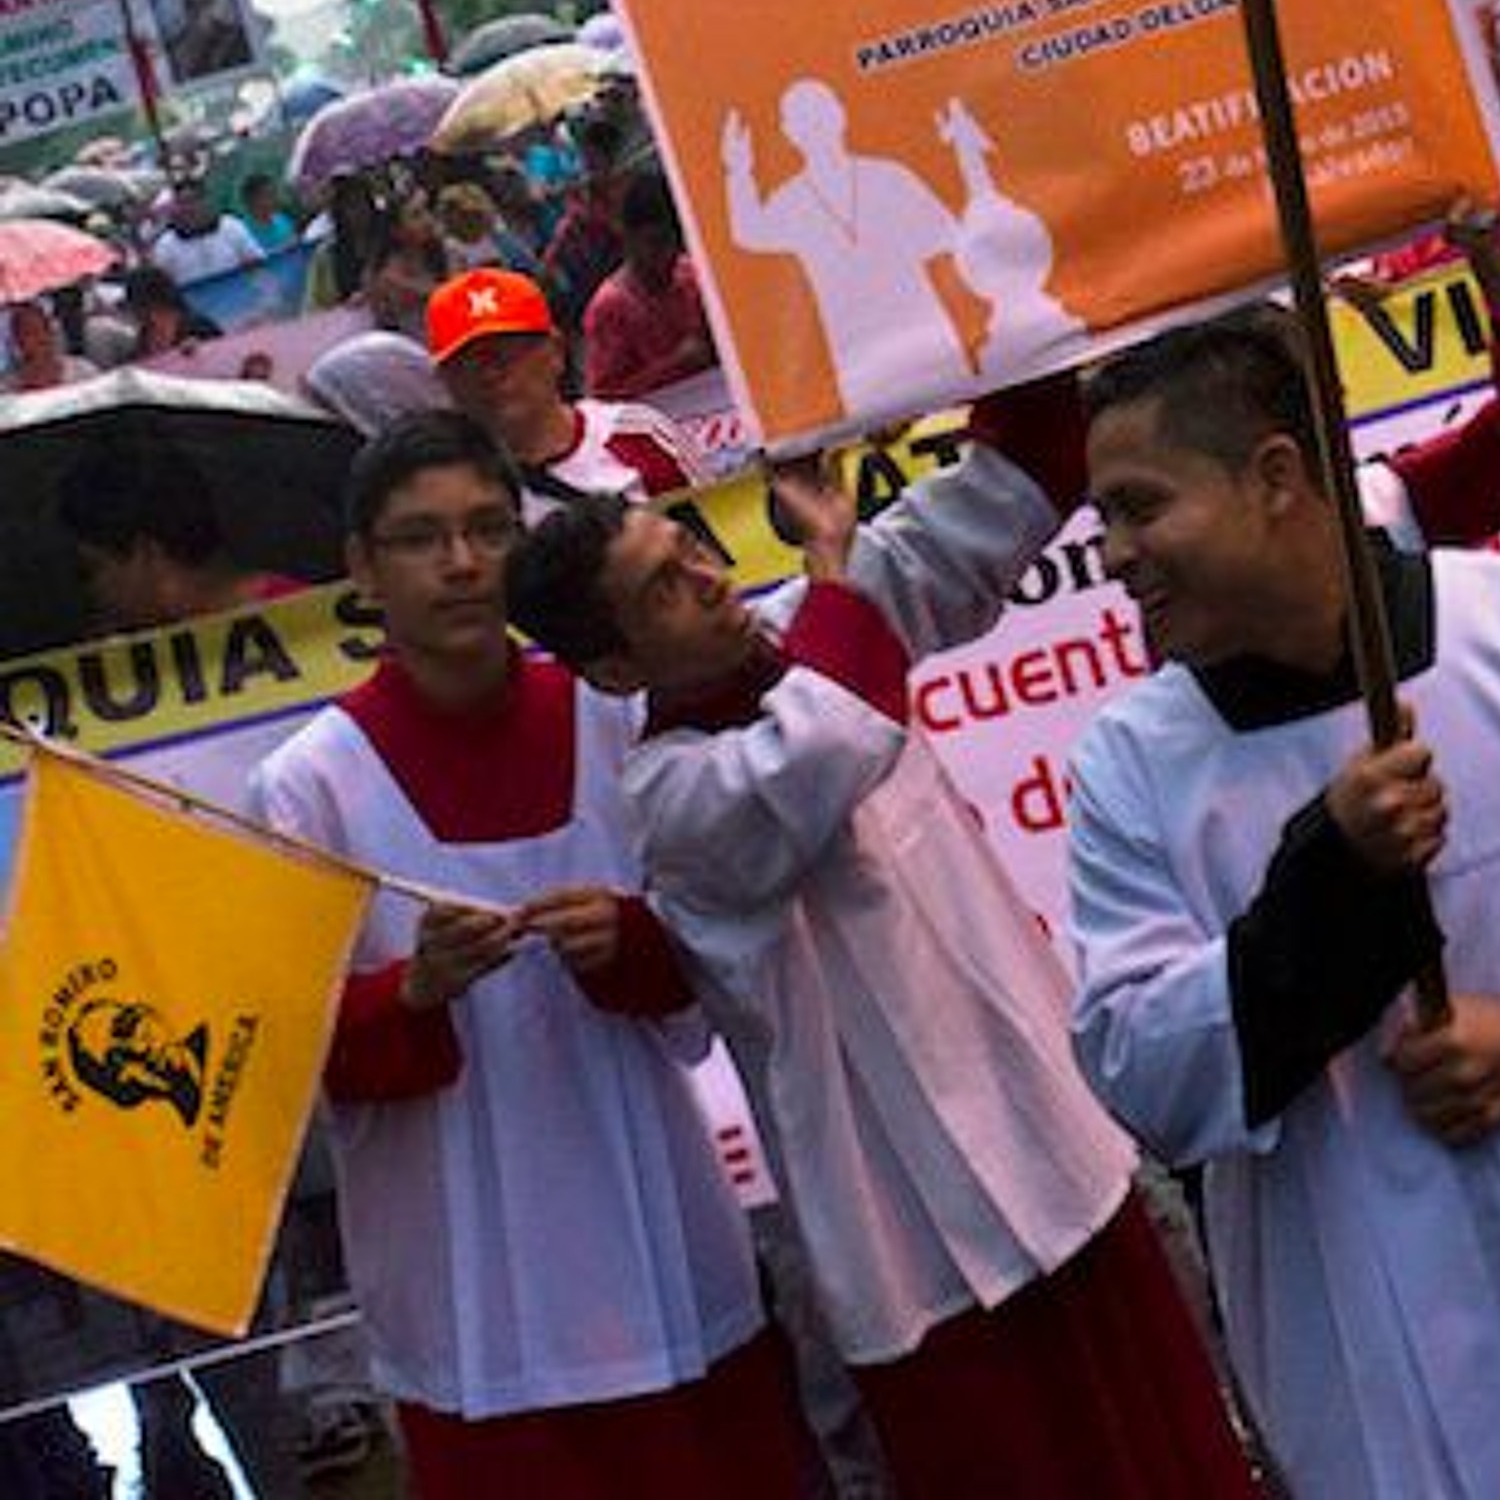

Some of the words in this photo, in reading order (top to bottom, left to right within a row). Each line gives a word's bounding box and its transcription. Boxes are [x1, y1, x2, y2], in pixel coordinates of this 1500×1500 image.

[856, 0, 1036, 69] PARROQUIA
[1020, 17, 1132, 66] CIUDAD
[1127, 51, 1393, 156] BEATIFICION
